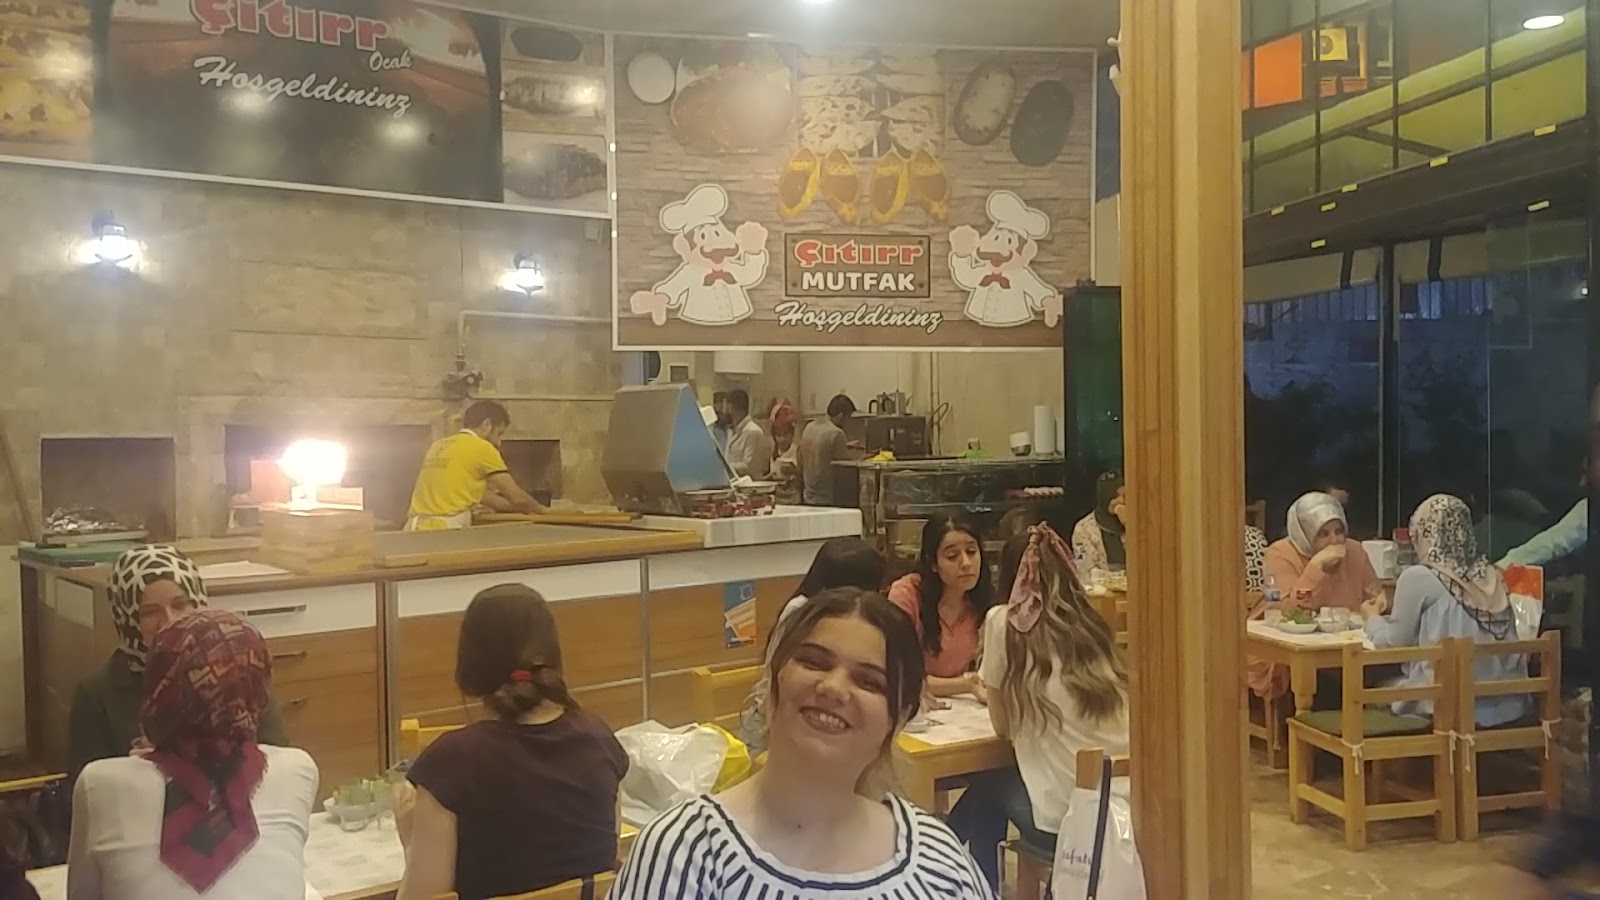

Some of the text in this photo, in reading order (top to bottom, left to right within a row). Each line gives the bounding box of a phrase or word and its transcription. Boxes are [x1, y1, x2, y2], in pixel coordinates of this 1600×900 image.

[369, 49, 412, 71] Ocak
[794, 239, 924, 268] Çıtırr
[801, 271, 916, 292] MUTFAK
[774, 300, 944, 334] Hoşgeldininz
